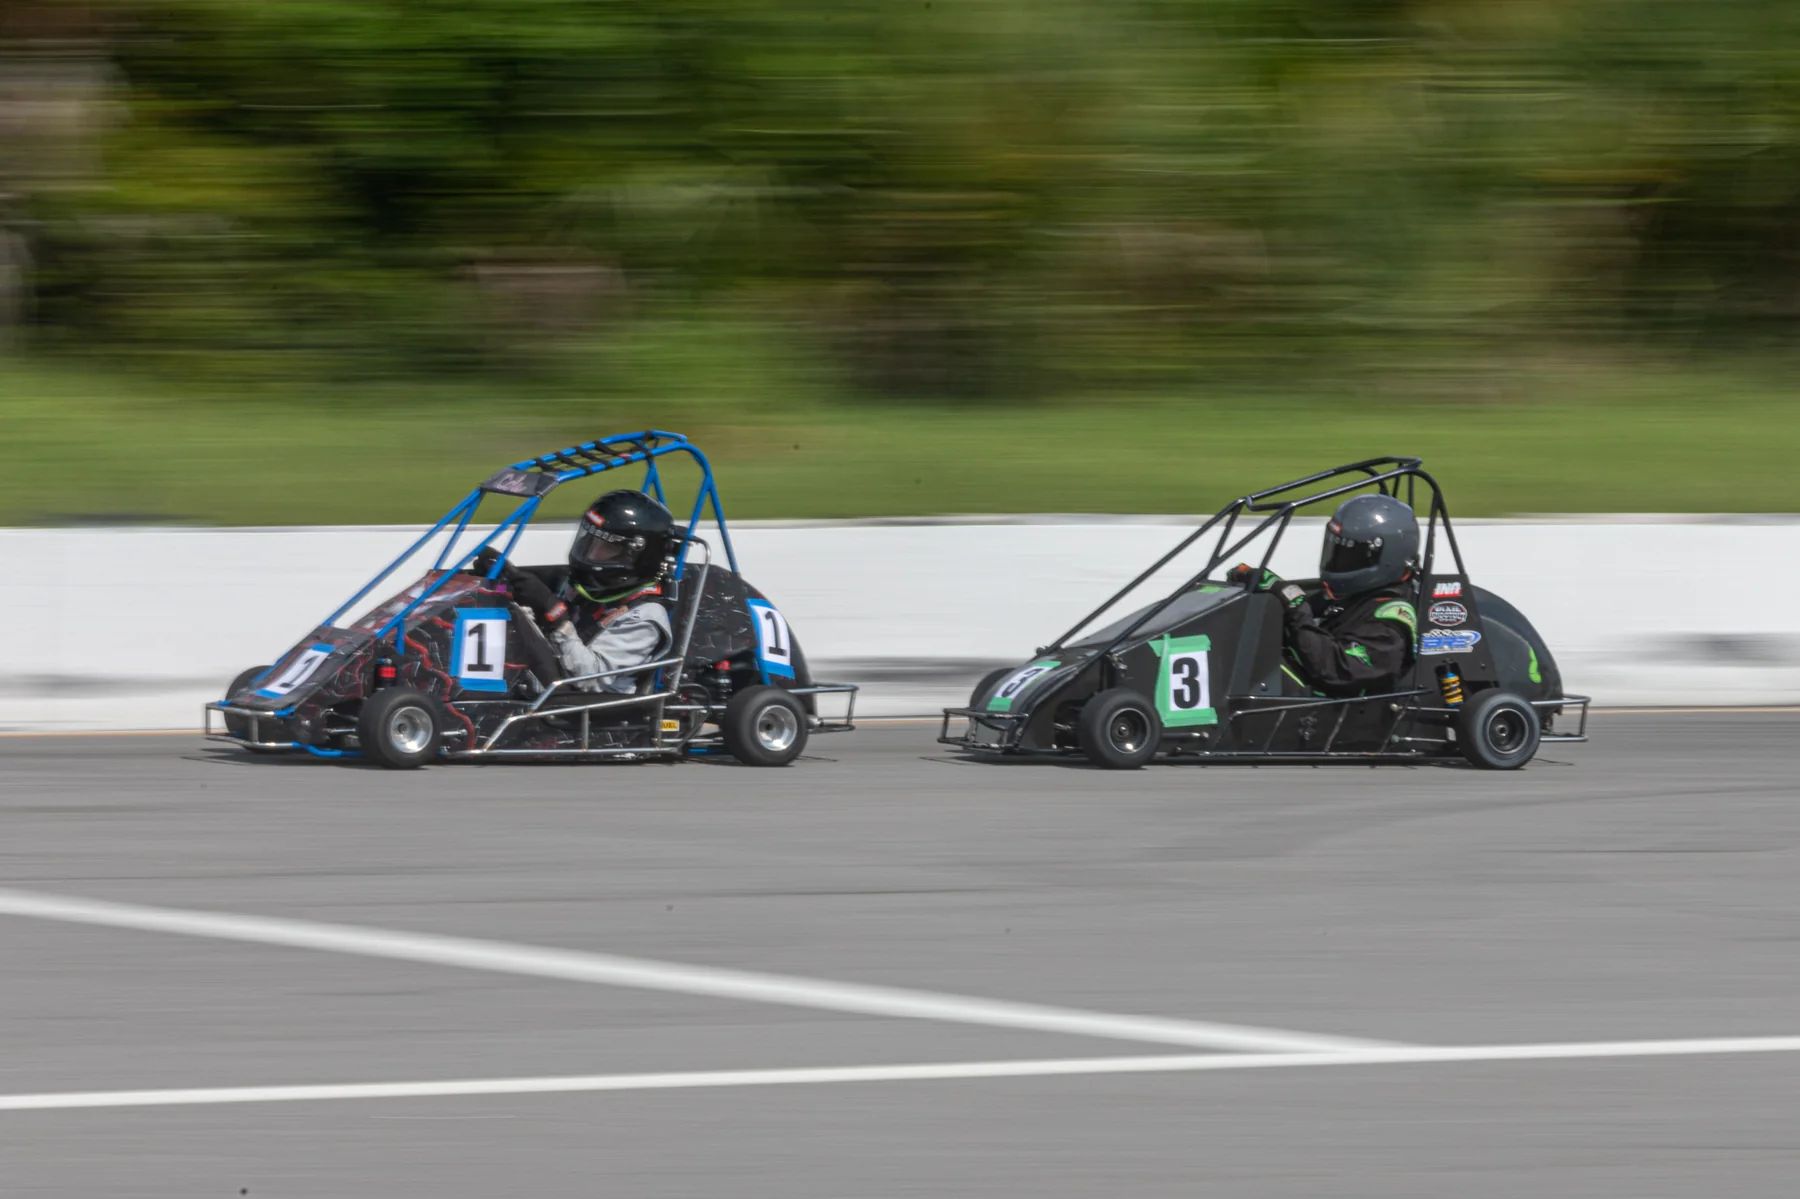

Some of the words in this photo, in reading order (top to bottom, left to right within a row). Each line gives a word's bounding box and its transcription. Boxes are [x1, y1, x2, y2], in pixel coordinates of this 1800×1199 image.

[466, 622, 493, 672] 1
[764, 610, 786, 656] 1
[280, 655, 321, 688] 1
[1002, 667, 1044, 698] 3
[1172, 657, 1201, 709] 3
